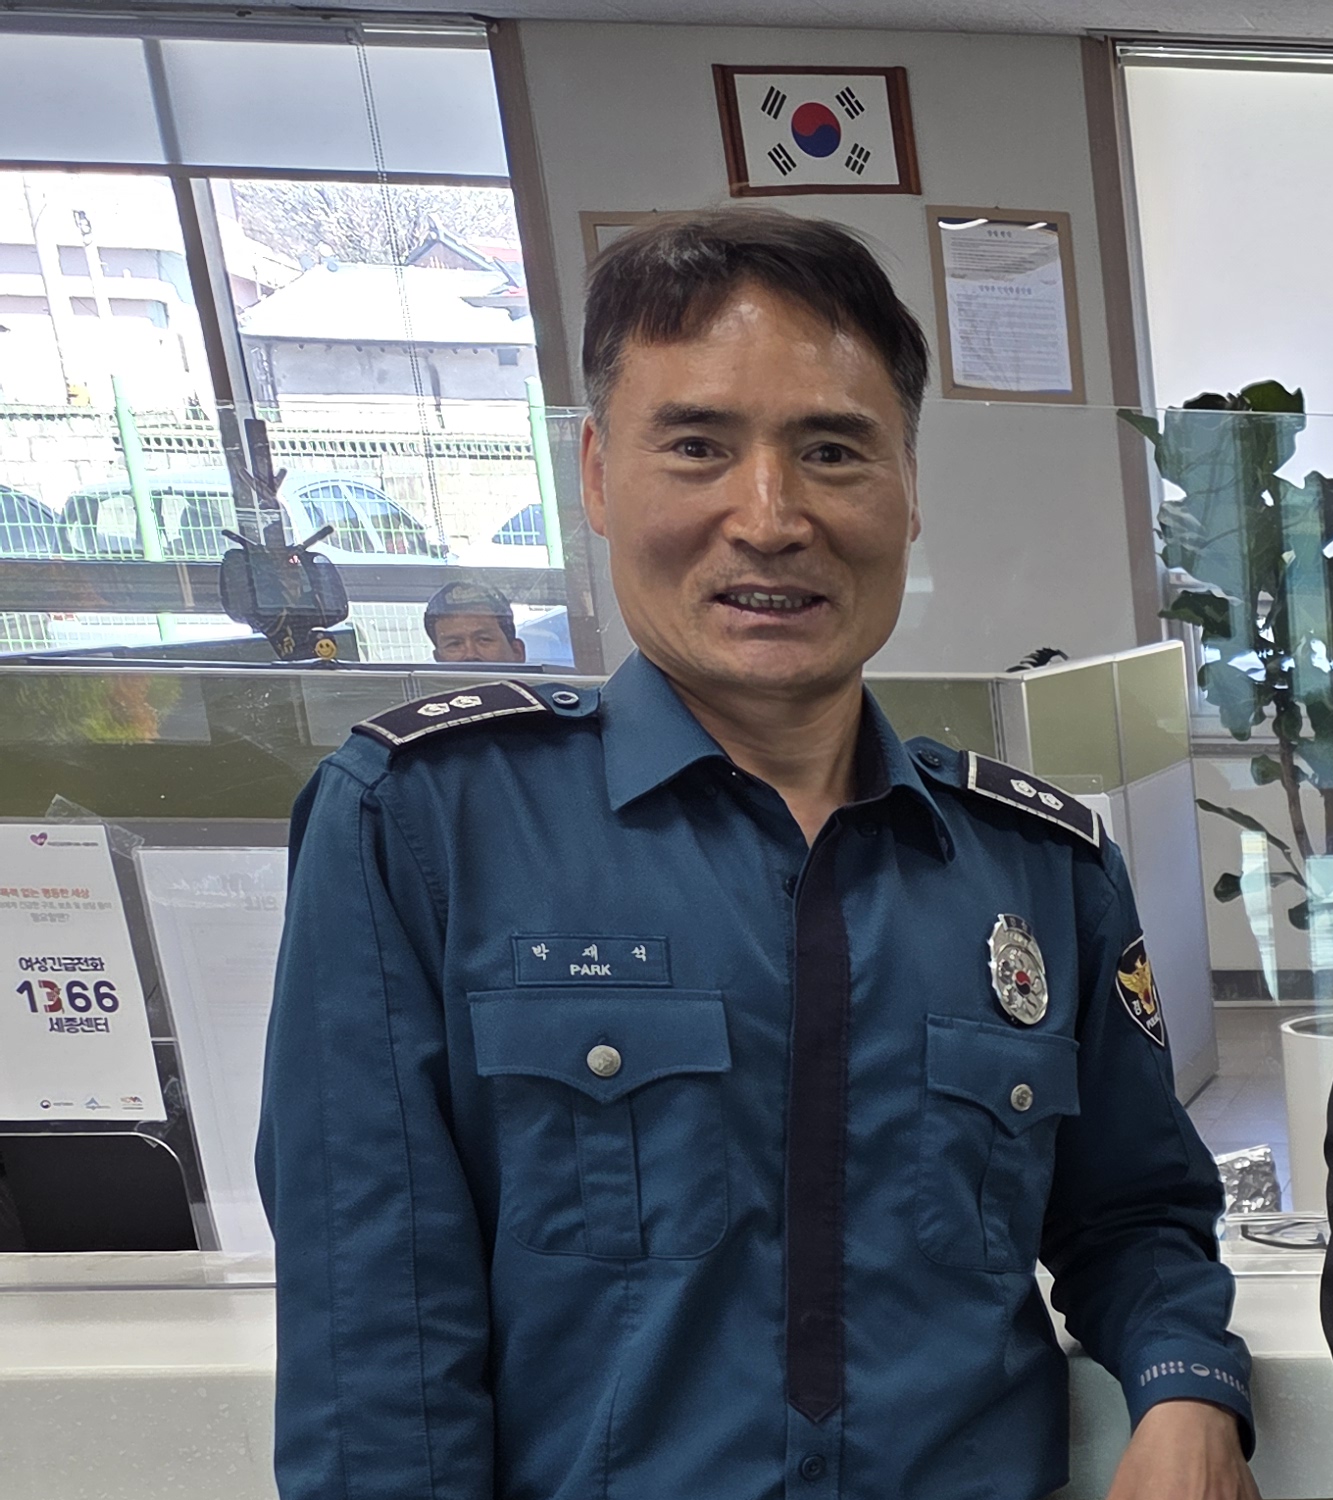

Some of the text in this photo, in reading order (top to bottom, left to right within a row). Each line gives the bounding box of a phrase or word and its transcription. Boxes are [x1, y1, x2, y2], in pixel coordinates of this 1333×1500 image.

[18, 956, 105, 972] 여성긴급전화
[569, 963, 612, 976] PARK
[16, 980, 119, 1014] 1366
[49, 1017, 110, 1033] 세종센터
